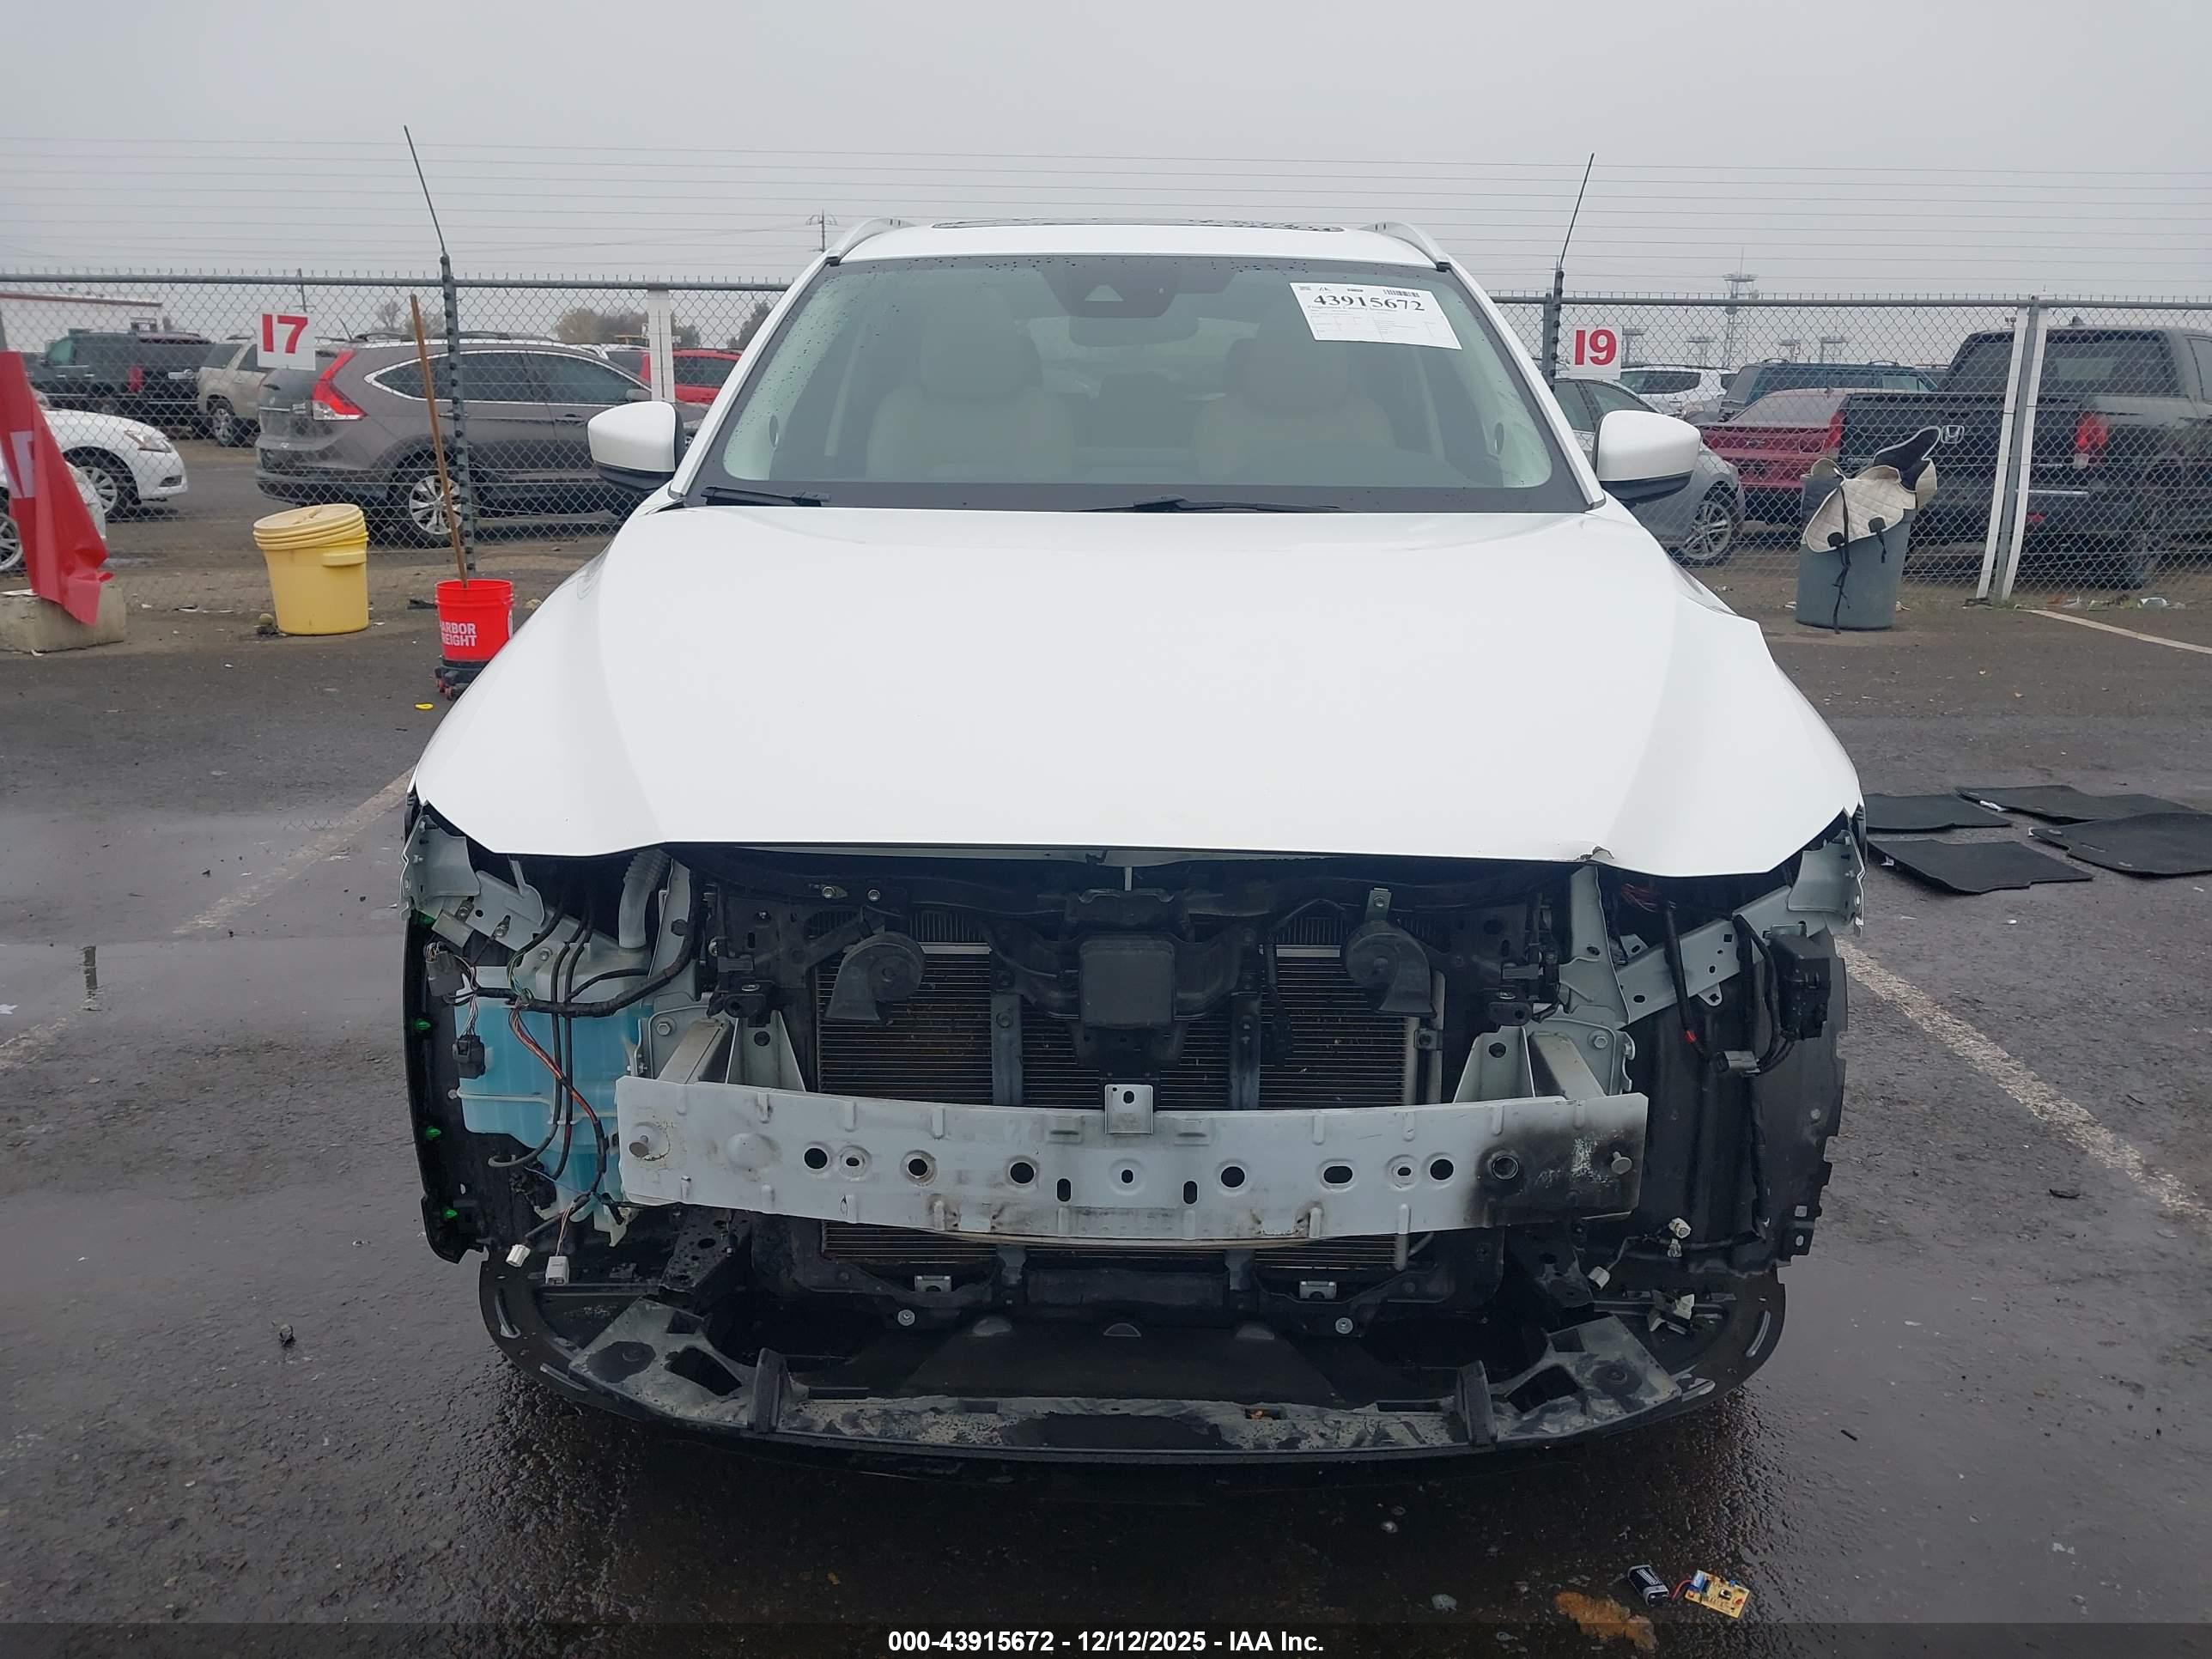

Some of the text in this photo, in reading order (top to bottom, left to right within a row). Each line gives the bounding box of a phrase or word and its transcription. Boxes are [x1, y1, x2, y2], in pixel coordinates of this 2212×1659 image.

[1314, 295, 1425, 311] 43915672
[262, 313, 308, 355] 17
[1574, 329, 1617, 366] 19
